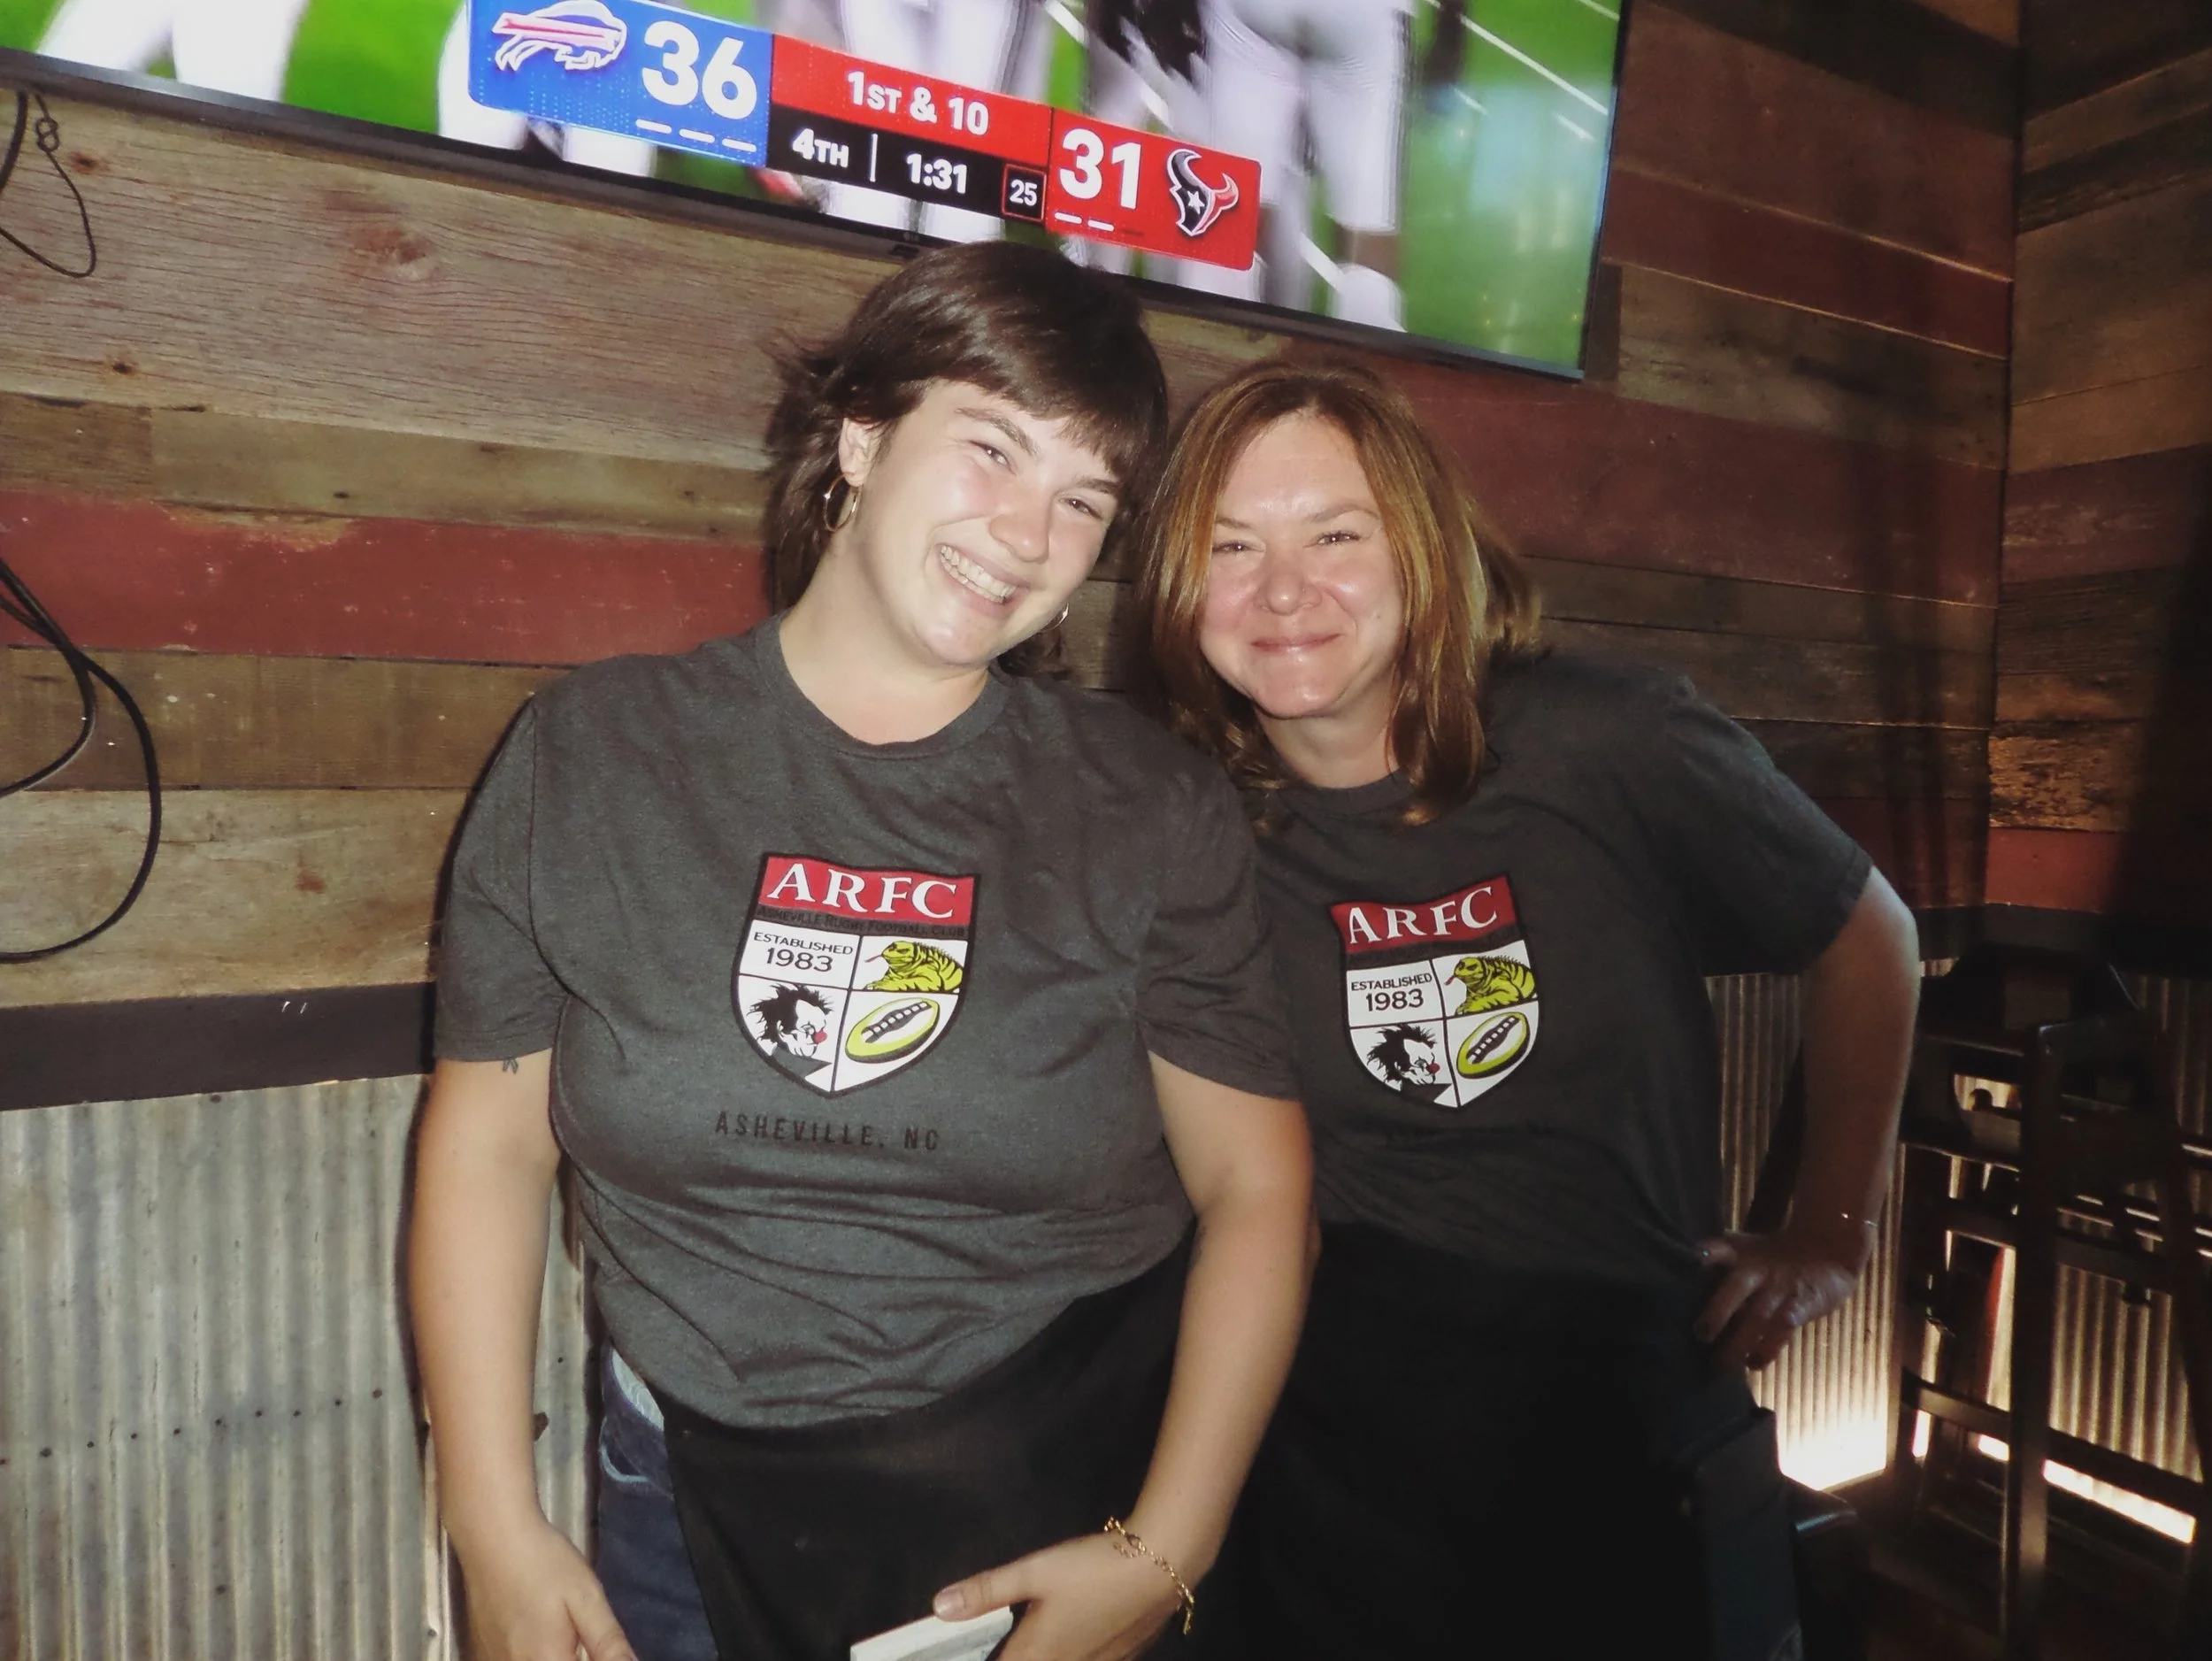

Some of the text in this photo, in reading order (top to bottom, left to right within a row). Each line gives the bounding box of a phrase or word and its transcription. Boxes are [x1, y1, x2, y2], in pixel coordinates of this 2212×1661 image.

[641, 20, 757, 120] 36
[847, 71, 990, 136] 1ST & 10
[792, 128, 968, 195] 4TH 1:31
[1059, 127, 1142, 210] 31
[1010, 179, 1039, 207] 25
[766, 863, 957, 919] ARFC
[1348, 886, 1498, 944] ARFC
[753, 932, 854, 956] ESTABLISHED
[766, 947, 833, 973] 1983
[1350, 973, 1432, 992] ESTABLISHED
[1365, 988, 1425, 1012] 1983
[903, 1126, 940, 1150] NC
